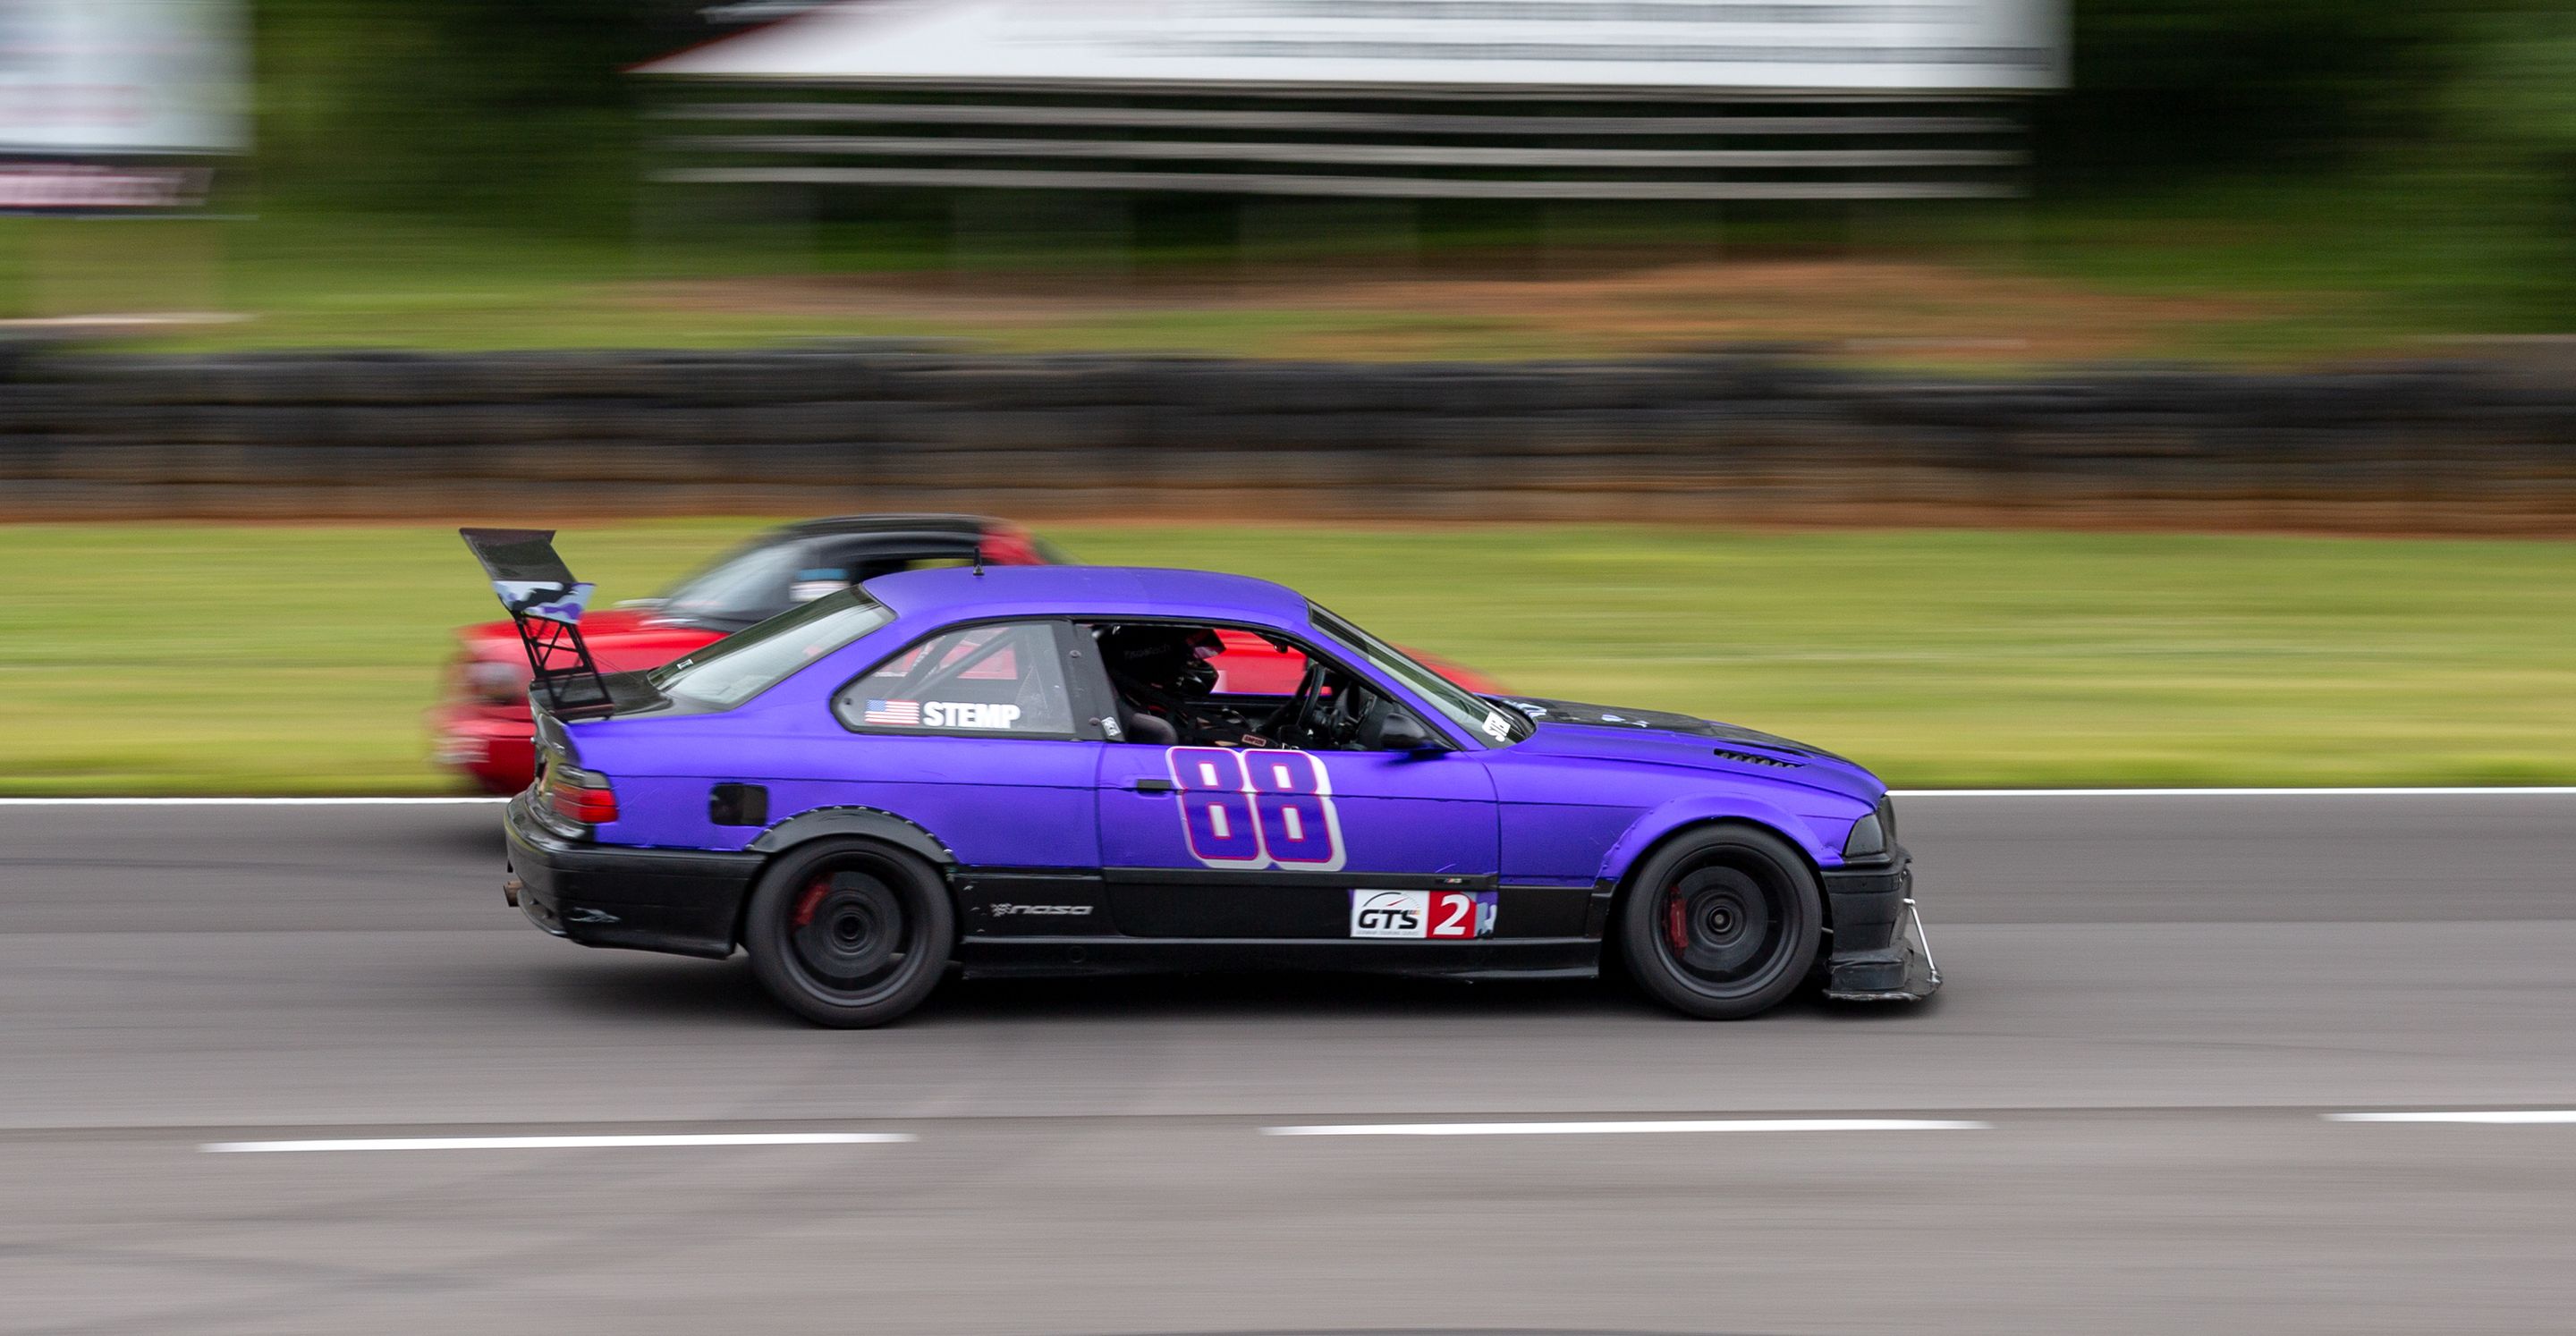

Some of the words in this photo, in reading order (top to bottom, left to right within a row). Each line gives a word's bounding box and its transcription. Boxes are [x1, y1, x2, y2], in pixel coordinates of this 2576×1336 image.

[923, 701, 1021, 729] STEMP
[1165, 746, 1347, 872] 88
[1010, 905, 1094, 915] nasa
[1359, 909, 1419, 929] GTS
[1433, 894, 1470, 935] 2
